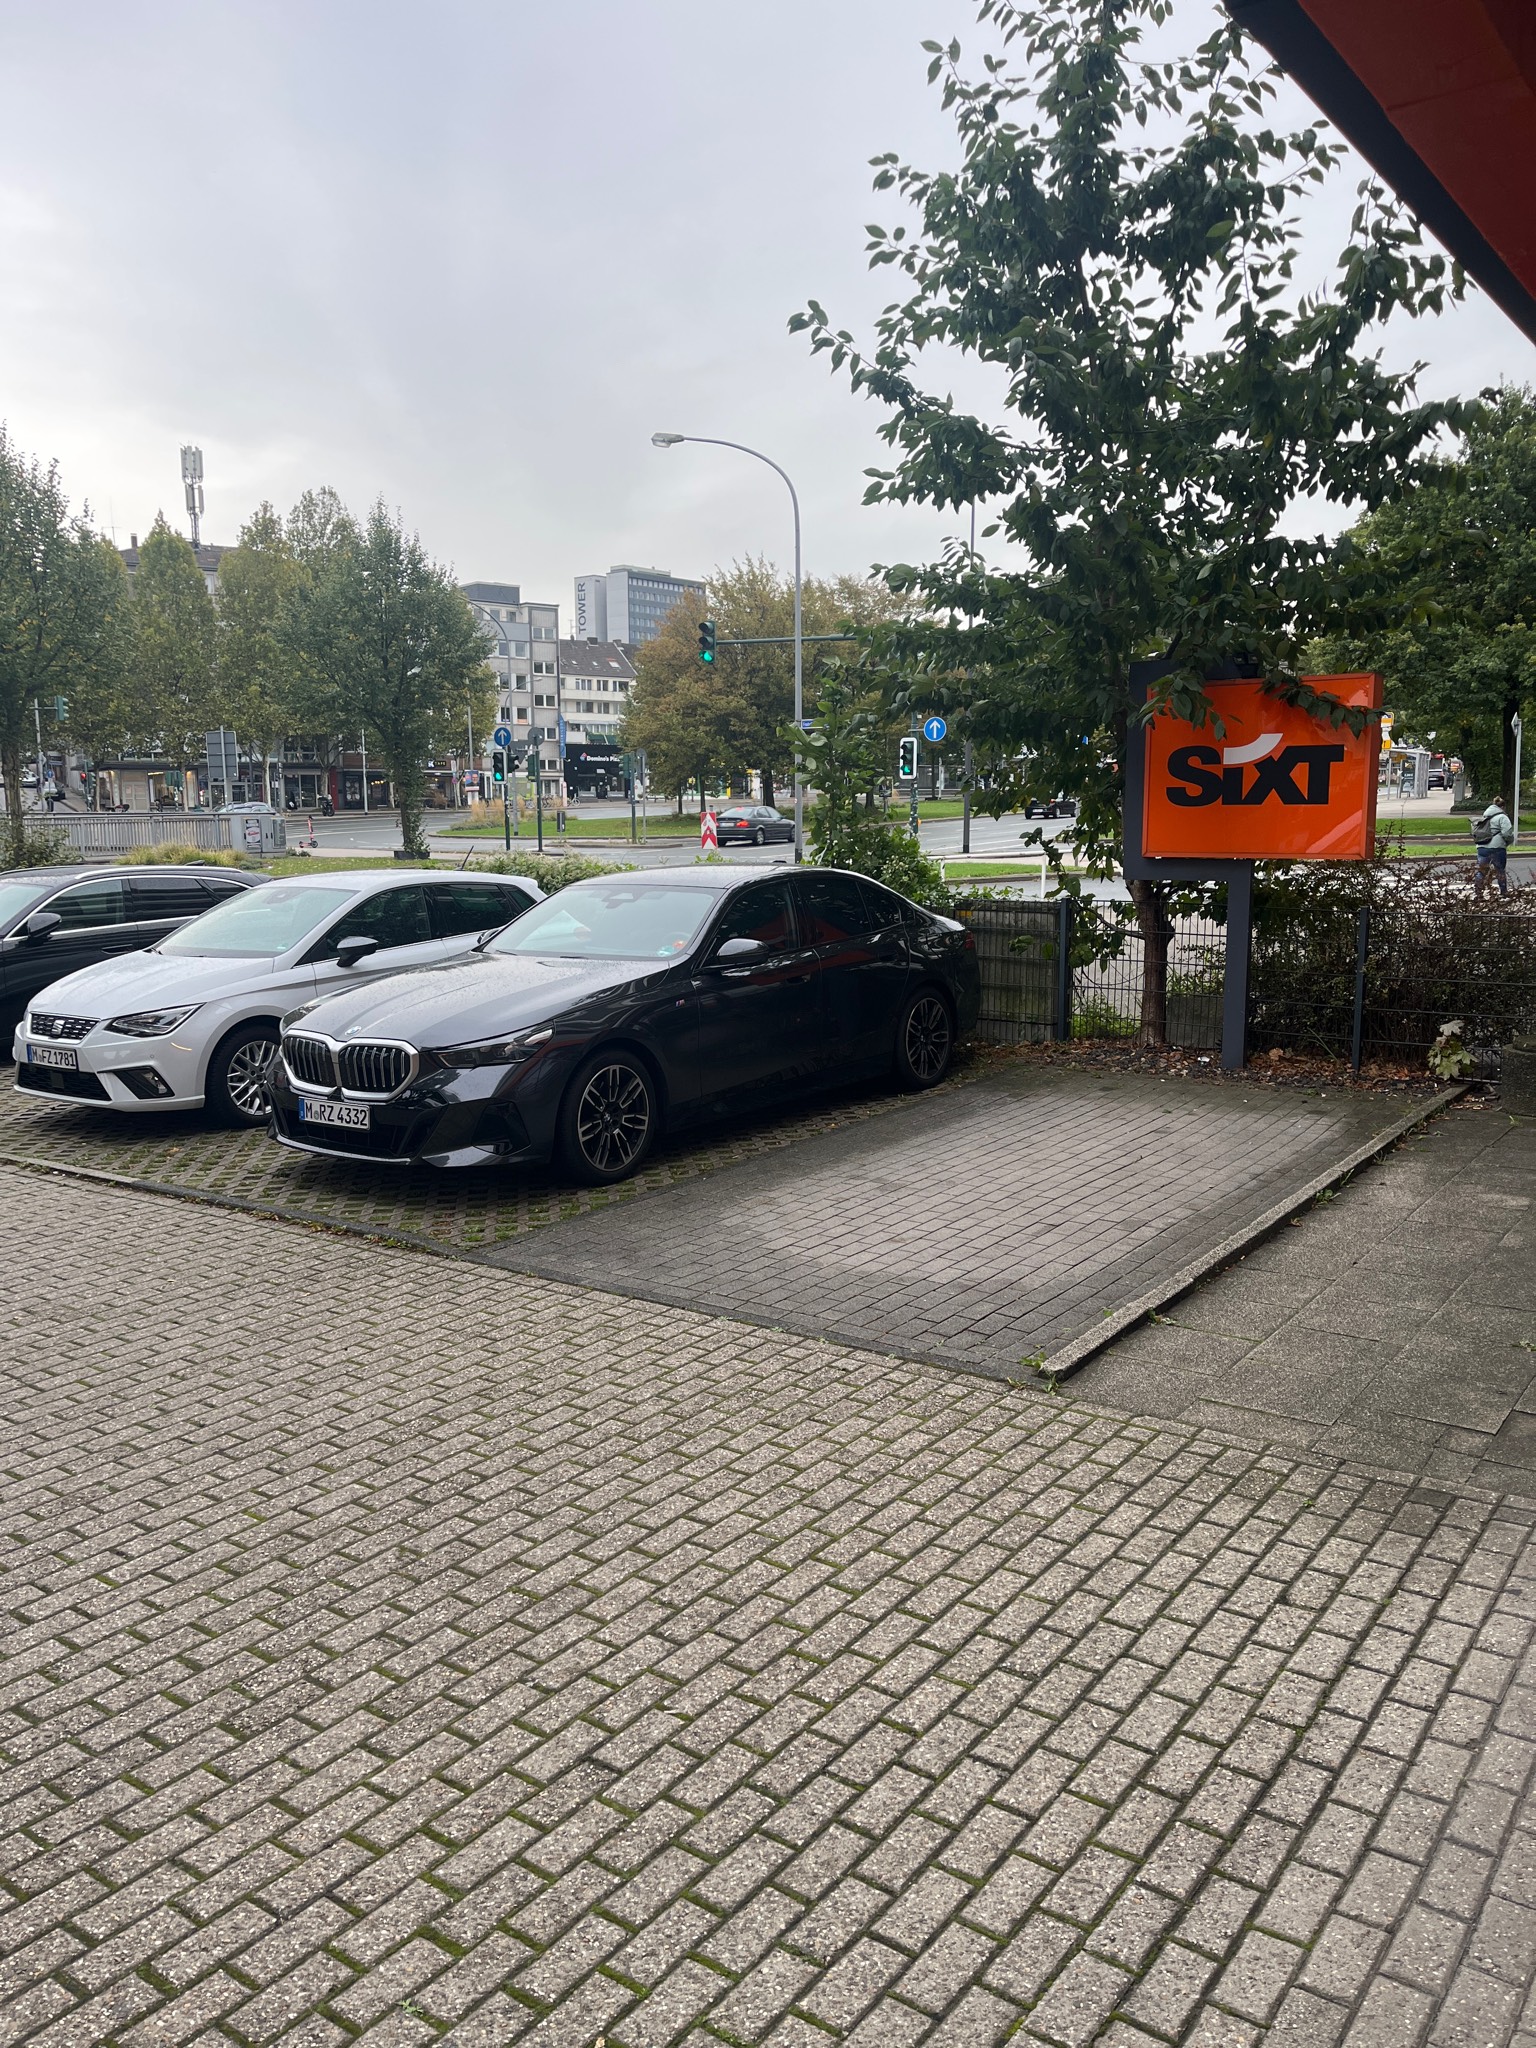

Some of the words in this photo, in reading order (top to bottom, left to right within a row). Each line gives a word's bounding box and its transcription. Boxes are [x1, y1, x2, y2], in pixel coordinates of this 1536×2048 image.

[577, 582, 587, 635] TOWER
[1166, 733, 1345, 806] SIXT
[32, 1047, 38, 1062] M
[41, 1049, 52, 1064] FZ
[53, 1051, 76, 1067] 1781
[305, 1102, 313, 1119] M
[319, 1104, 335, 1122] RZ
[336, 1107, 368, 1127] 4332
